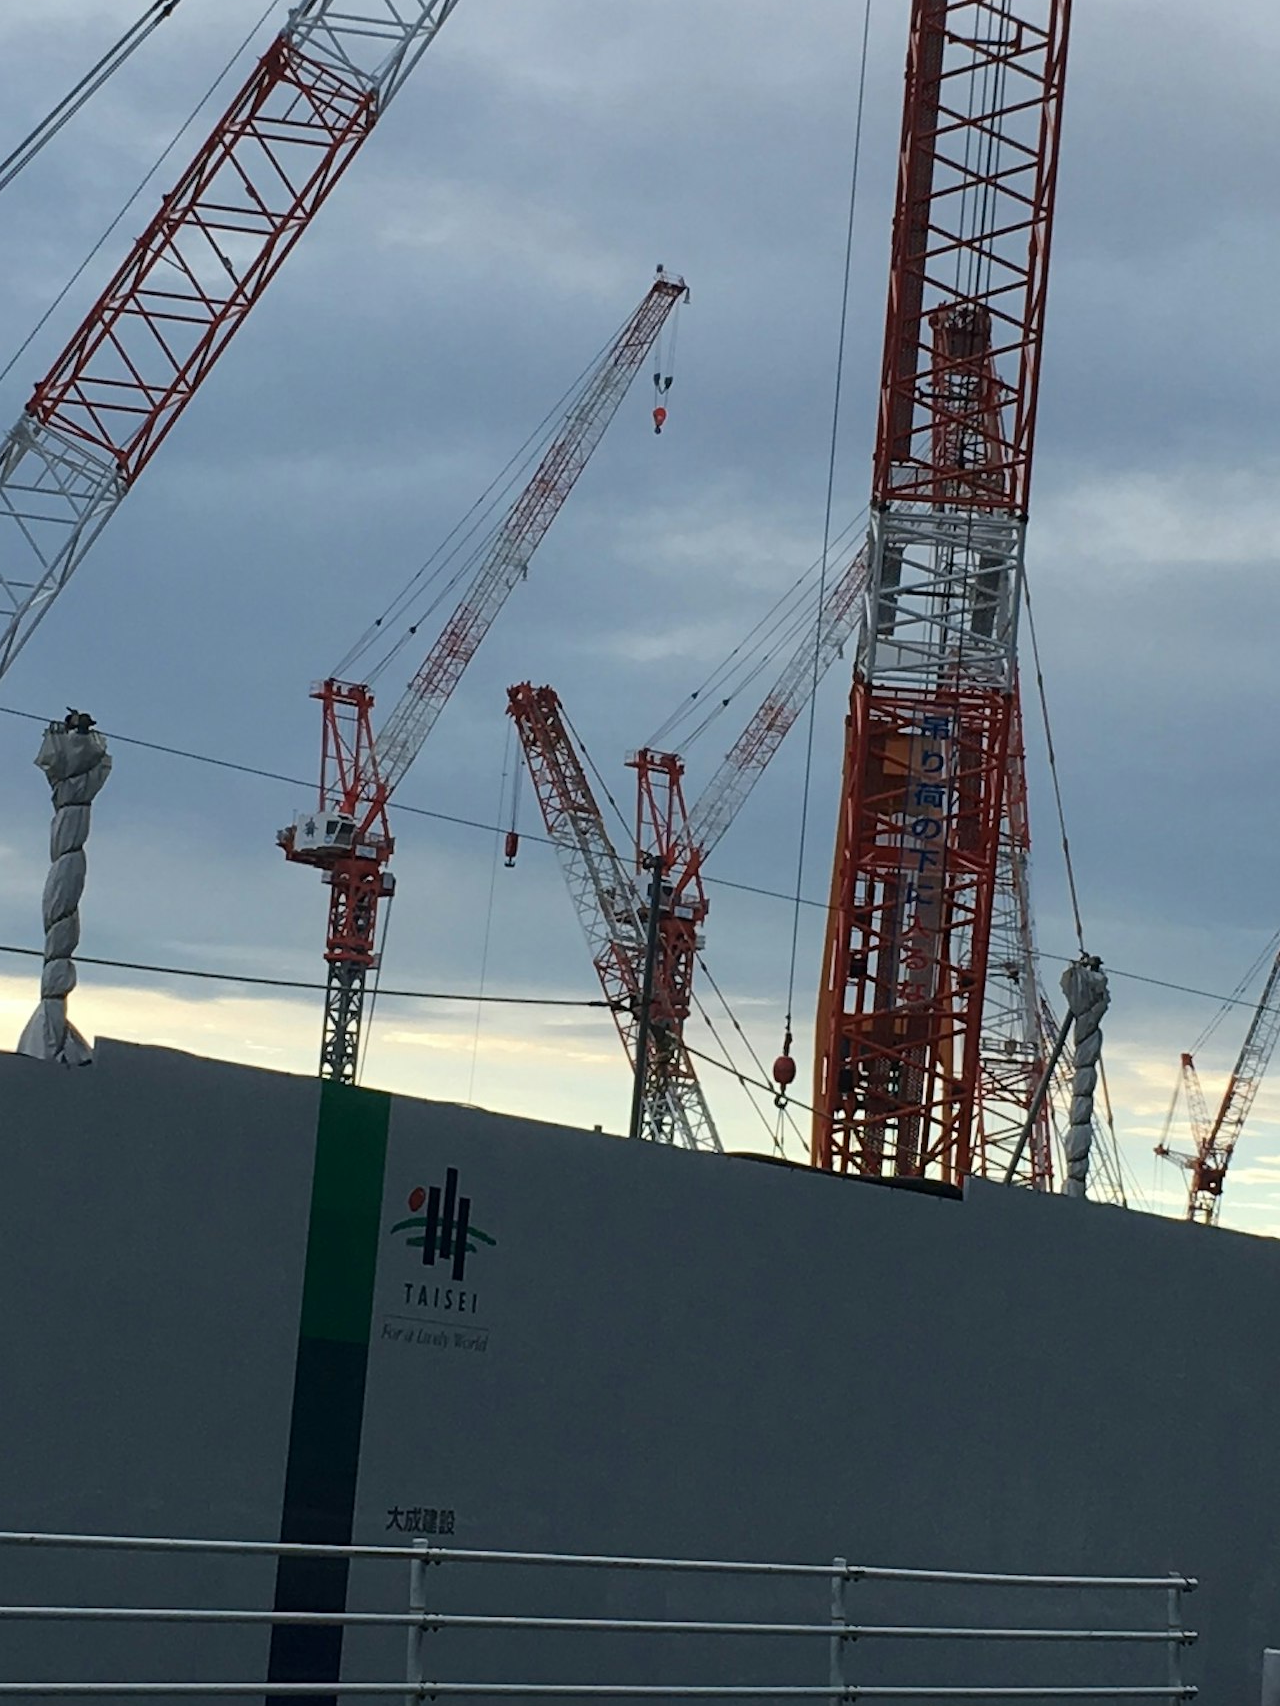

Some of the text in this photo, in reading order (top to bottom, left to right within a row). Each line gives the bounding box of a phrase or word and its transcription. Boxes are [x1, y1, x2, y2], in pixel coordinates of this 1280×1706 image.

[404, 1282, 478, 1314] TAISEI
[385, 1505, 455, 1536] 大成建設
